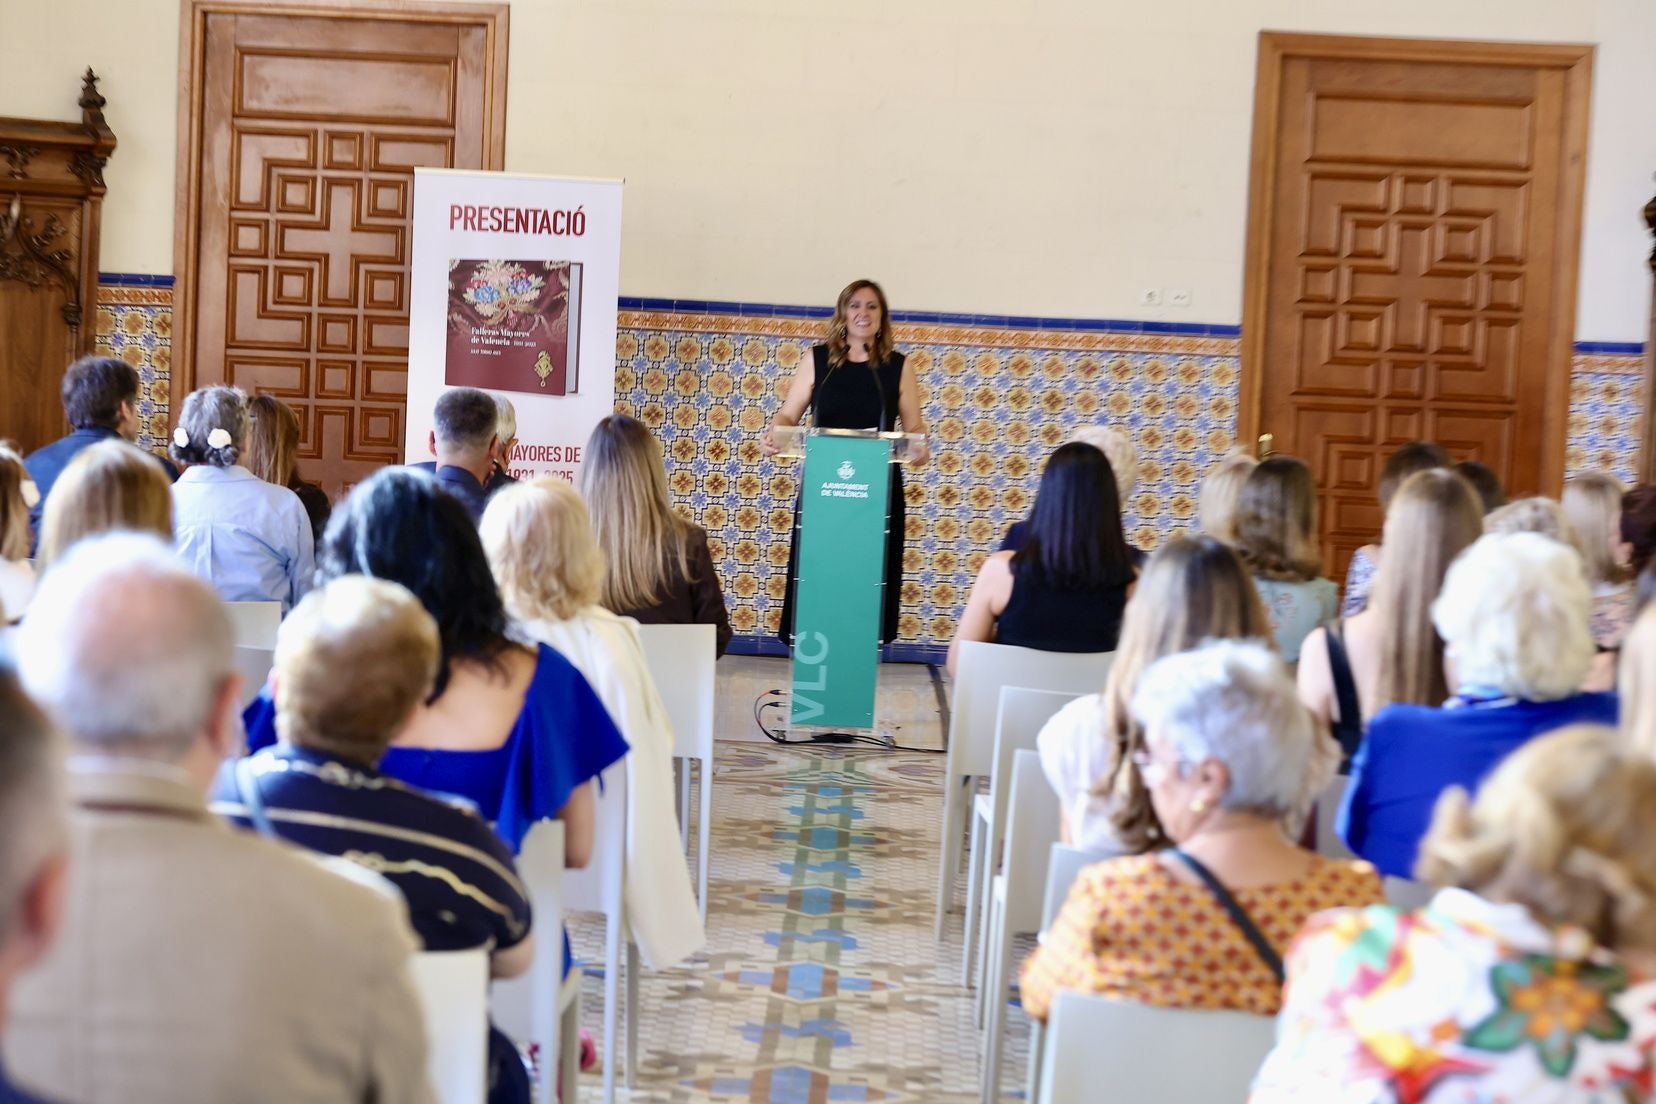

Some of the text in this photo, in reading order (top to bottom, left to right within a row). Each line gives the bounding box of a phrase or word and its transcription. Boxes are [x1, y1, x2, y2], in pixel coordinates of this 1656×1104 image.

[449, 204, 586, 237] PRESENTACIÓ
[471, 326, 530, 338] Falleras Mayores
[470, 336, 480, 344] de
[481, 337, 510, 346] Valencia
[565, 447, 581, 463] DE
[821, 489, 832, 497] DE
[791, 631, 829, 724] VLC
